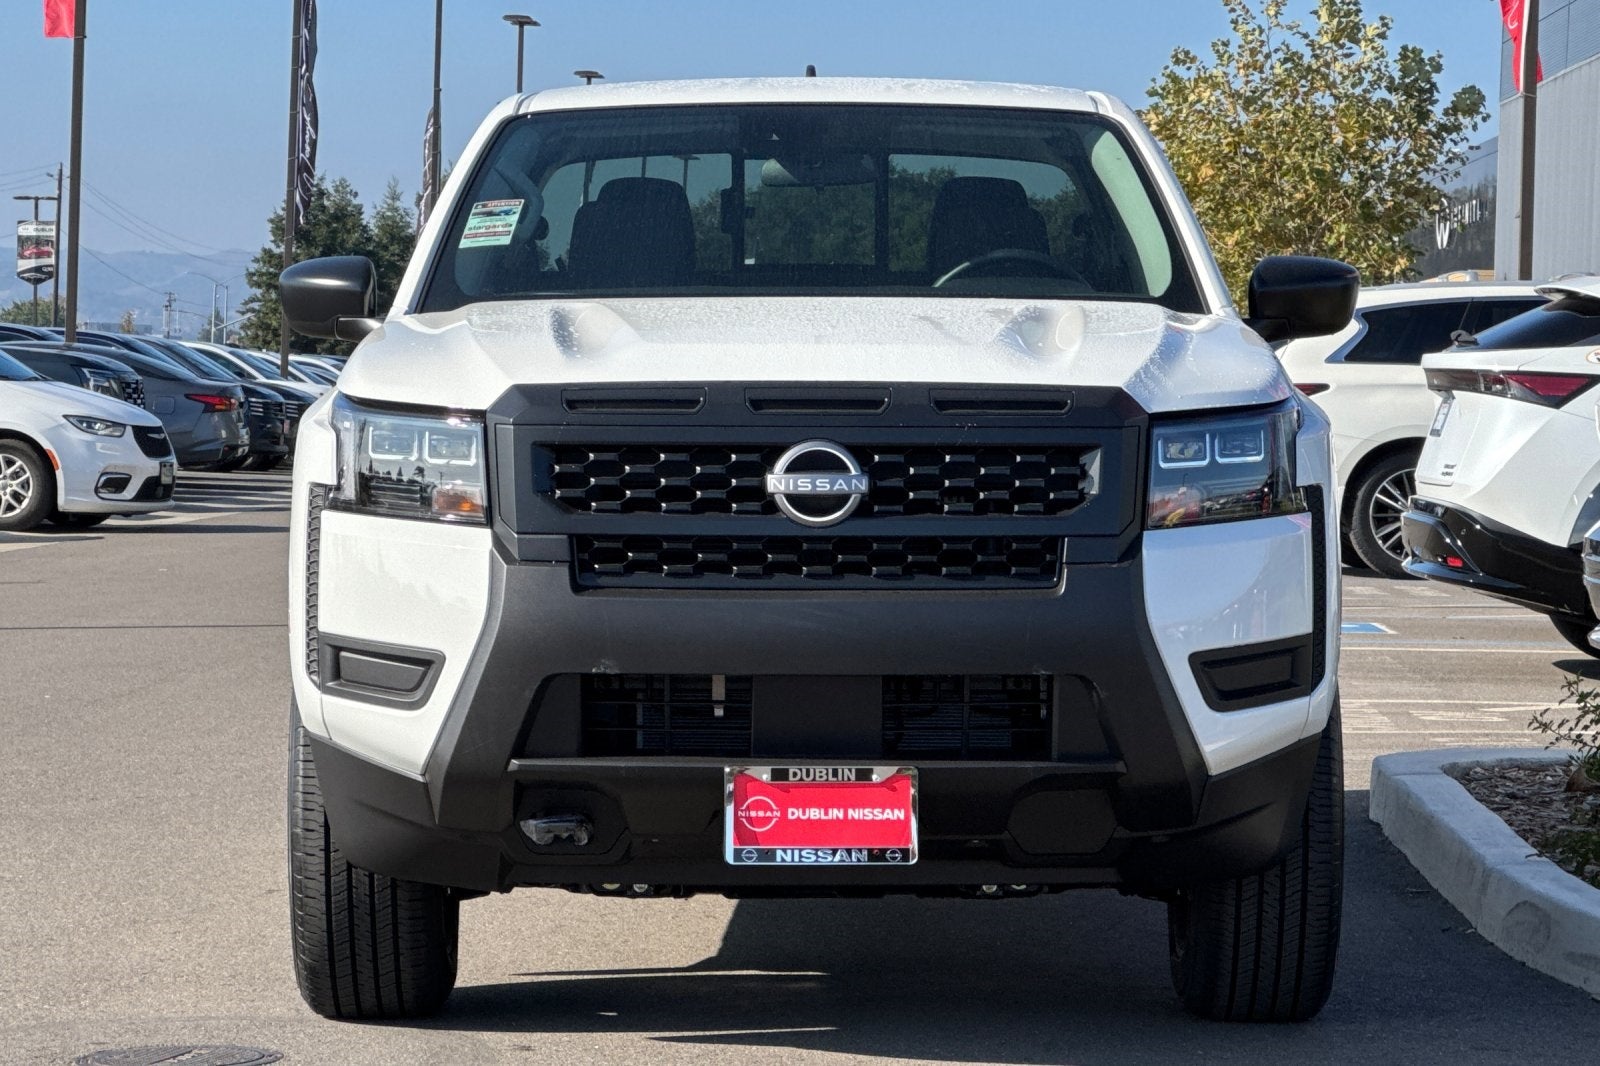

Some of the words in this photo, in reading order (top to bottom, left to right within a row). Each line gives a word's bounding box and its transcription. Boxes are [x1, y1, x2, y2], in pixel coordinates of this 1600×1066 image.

[770, 478, 866, 491] NISSAN
[789, 768, 855, 781] DUBLIN
[737, 809, 781, 818] NISSAN
[787, 807, 844, 820] DUBLIN
[848, 807, 905, 820] NISSAN
[776, 849, 868, 862] NISSAN
